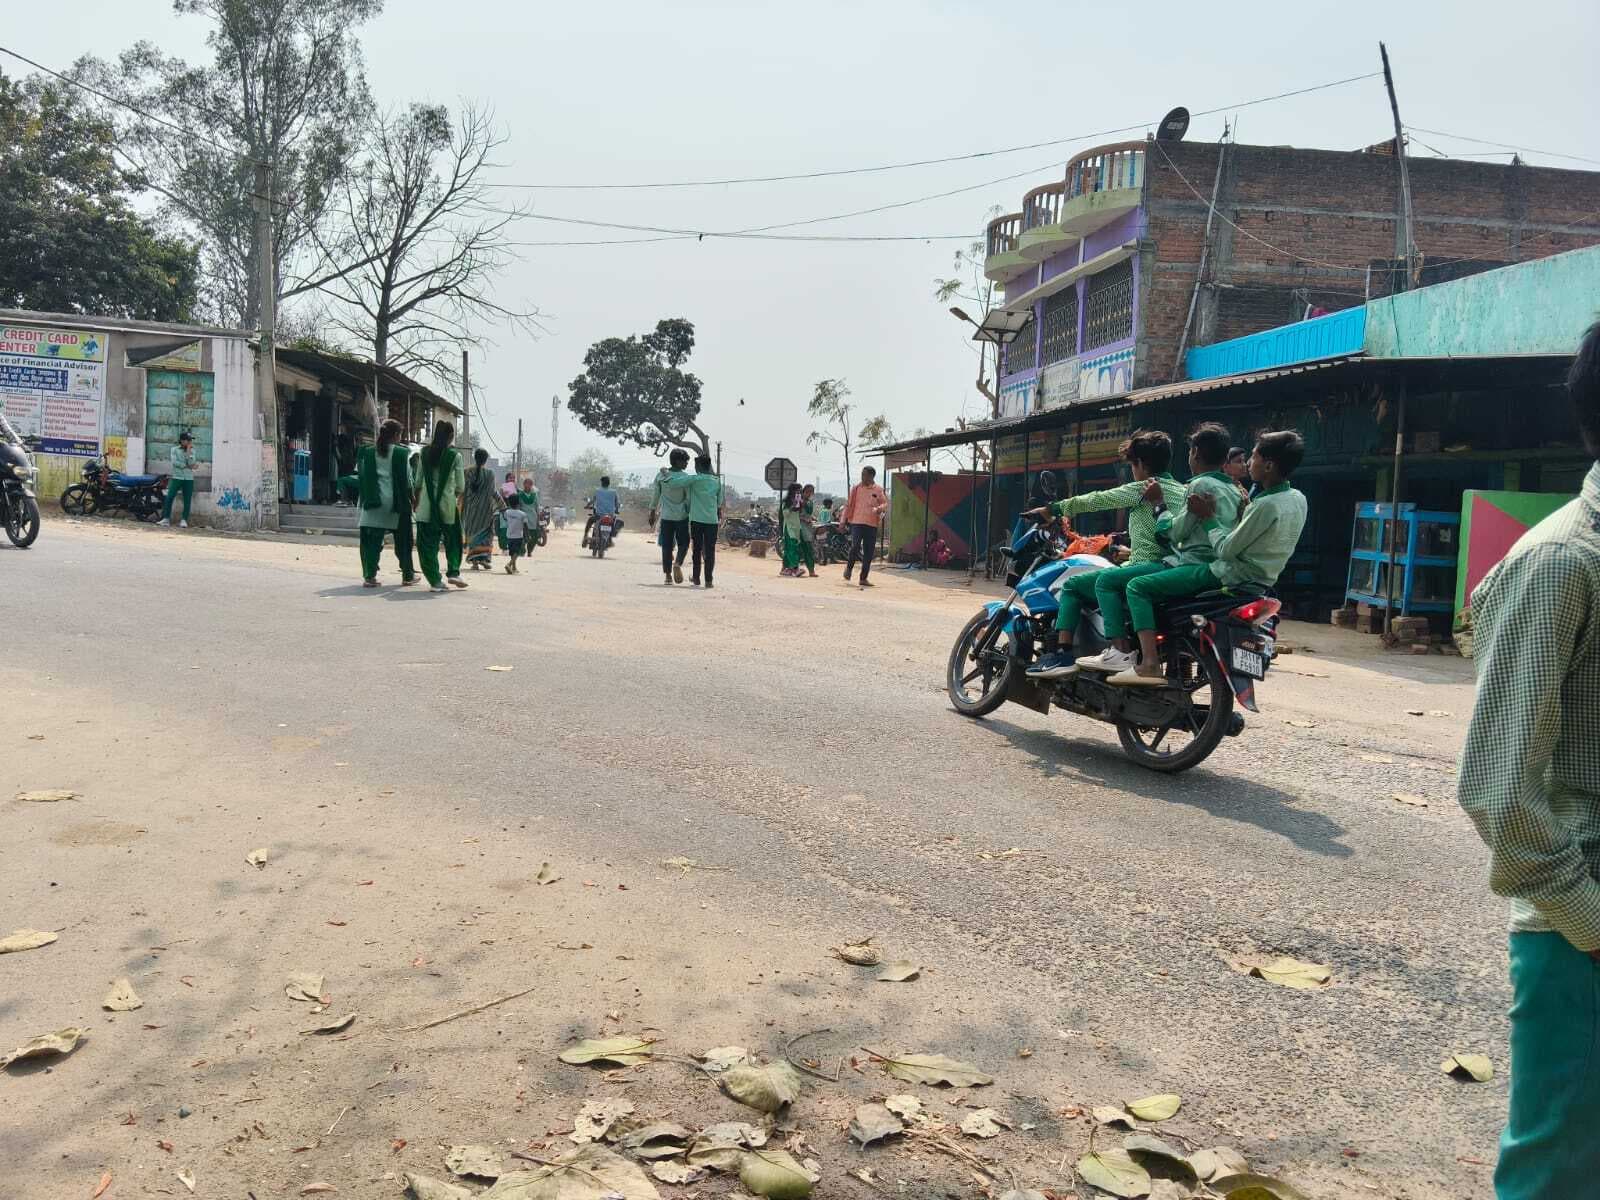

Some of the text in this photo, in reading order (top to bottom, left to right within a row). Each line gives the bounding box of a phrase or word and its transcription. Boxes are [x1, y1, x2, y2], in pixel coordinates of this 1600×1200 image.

[4, 329, 78, 345] CREDIT CARD
[23, 357, 62, 368] Financial
[64, 361, 97, 370] Advisor
